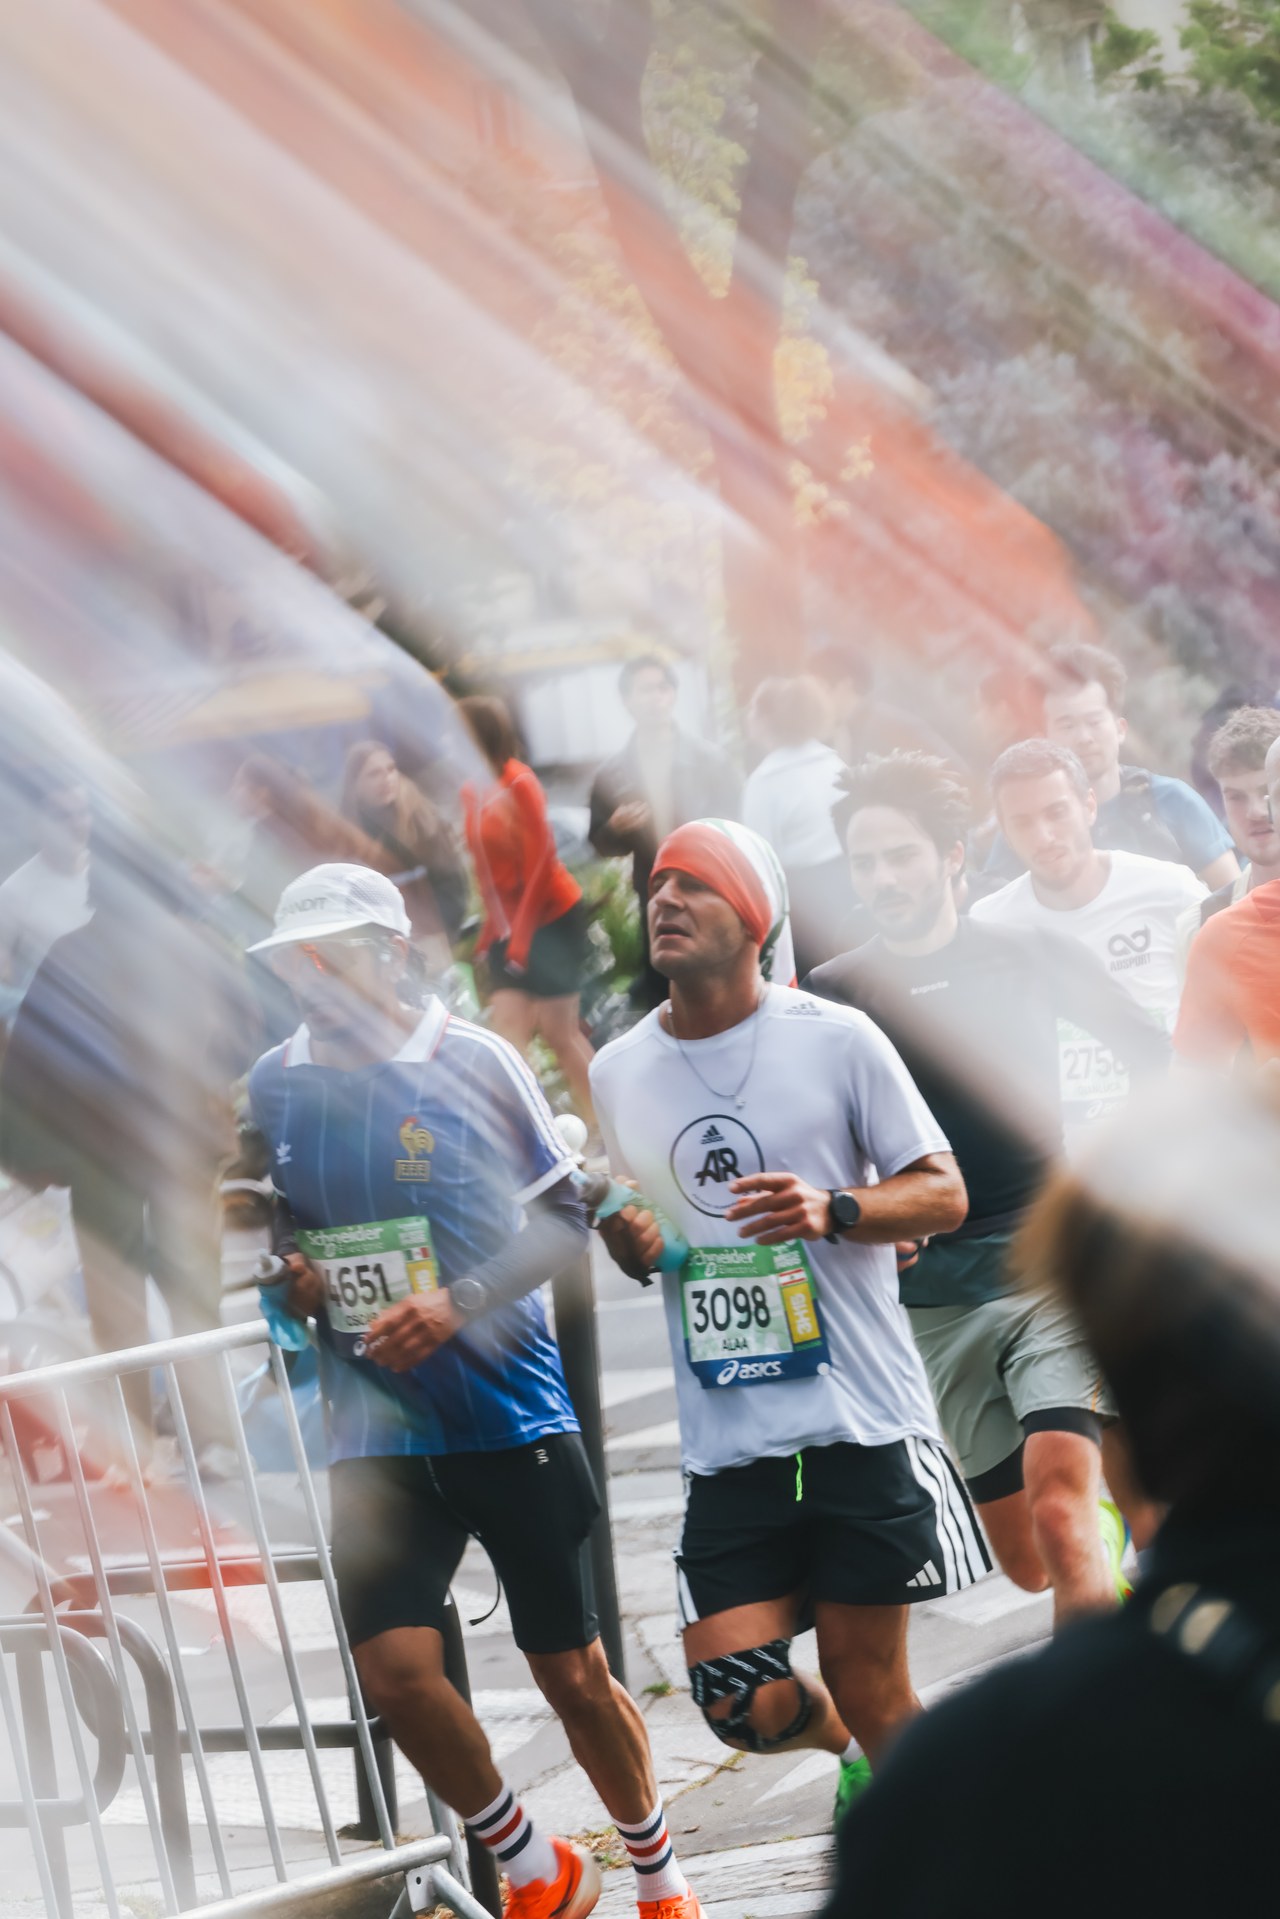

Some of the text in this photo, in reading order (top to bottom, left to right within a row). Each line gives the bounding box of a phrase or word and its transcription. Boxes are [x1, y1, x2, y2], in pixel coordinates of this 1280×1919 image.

[691, 1285, 771, 1334] 3098
[722, 1338, 749, 1351] ALAA
[738, 1360, 783, 1380] asics
